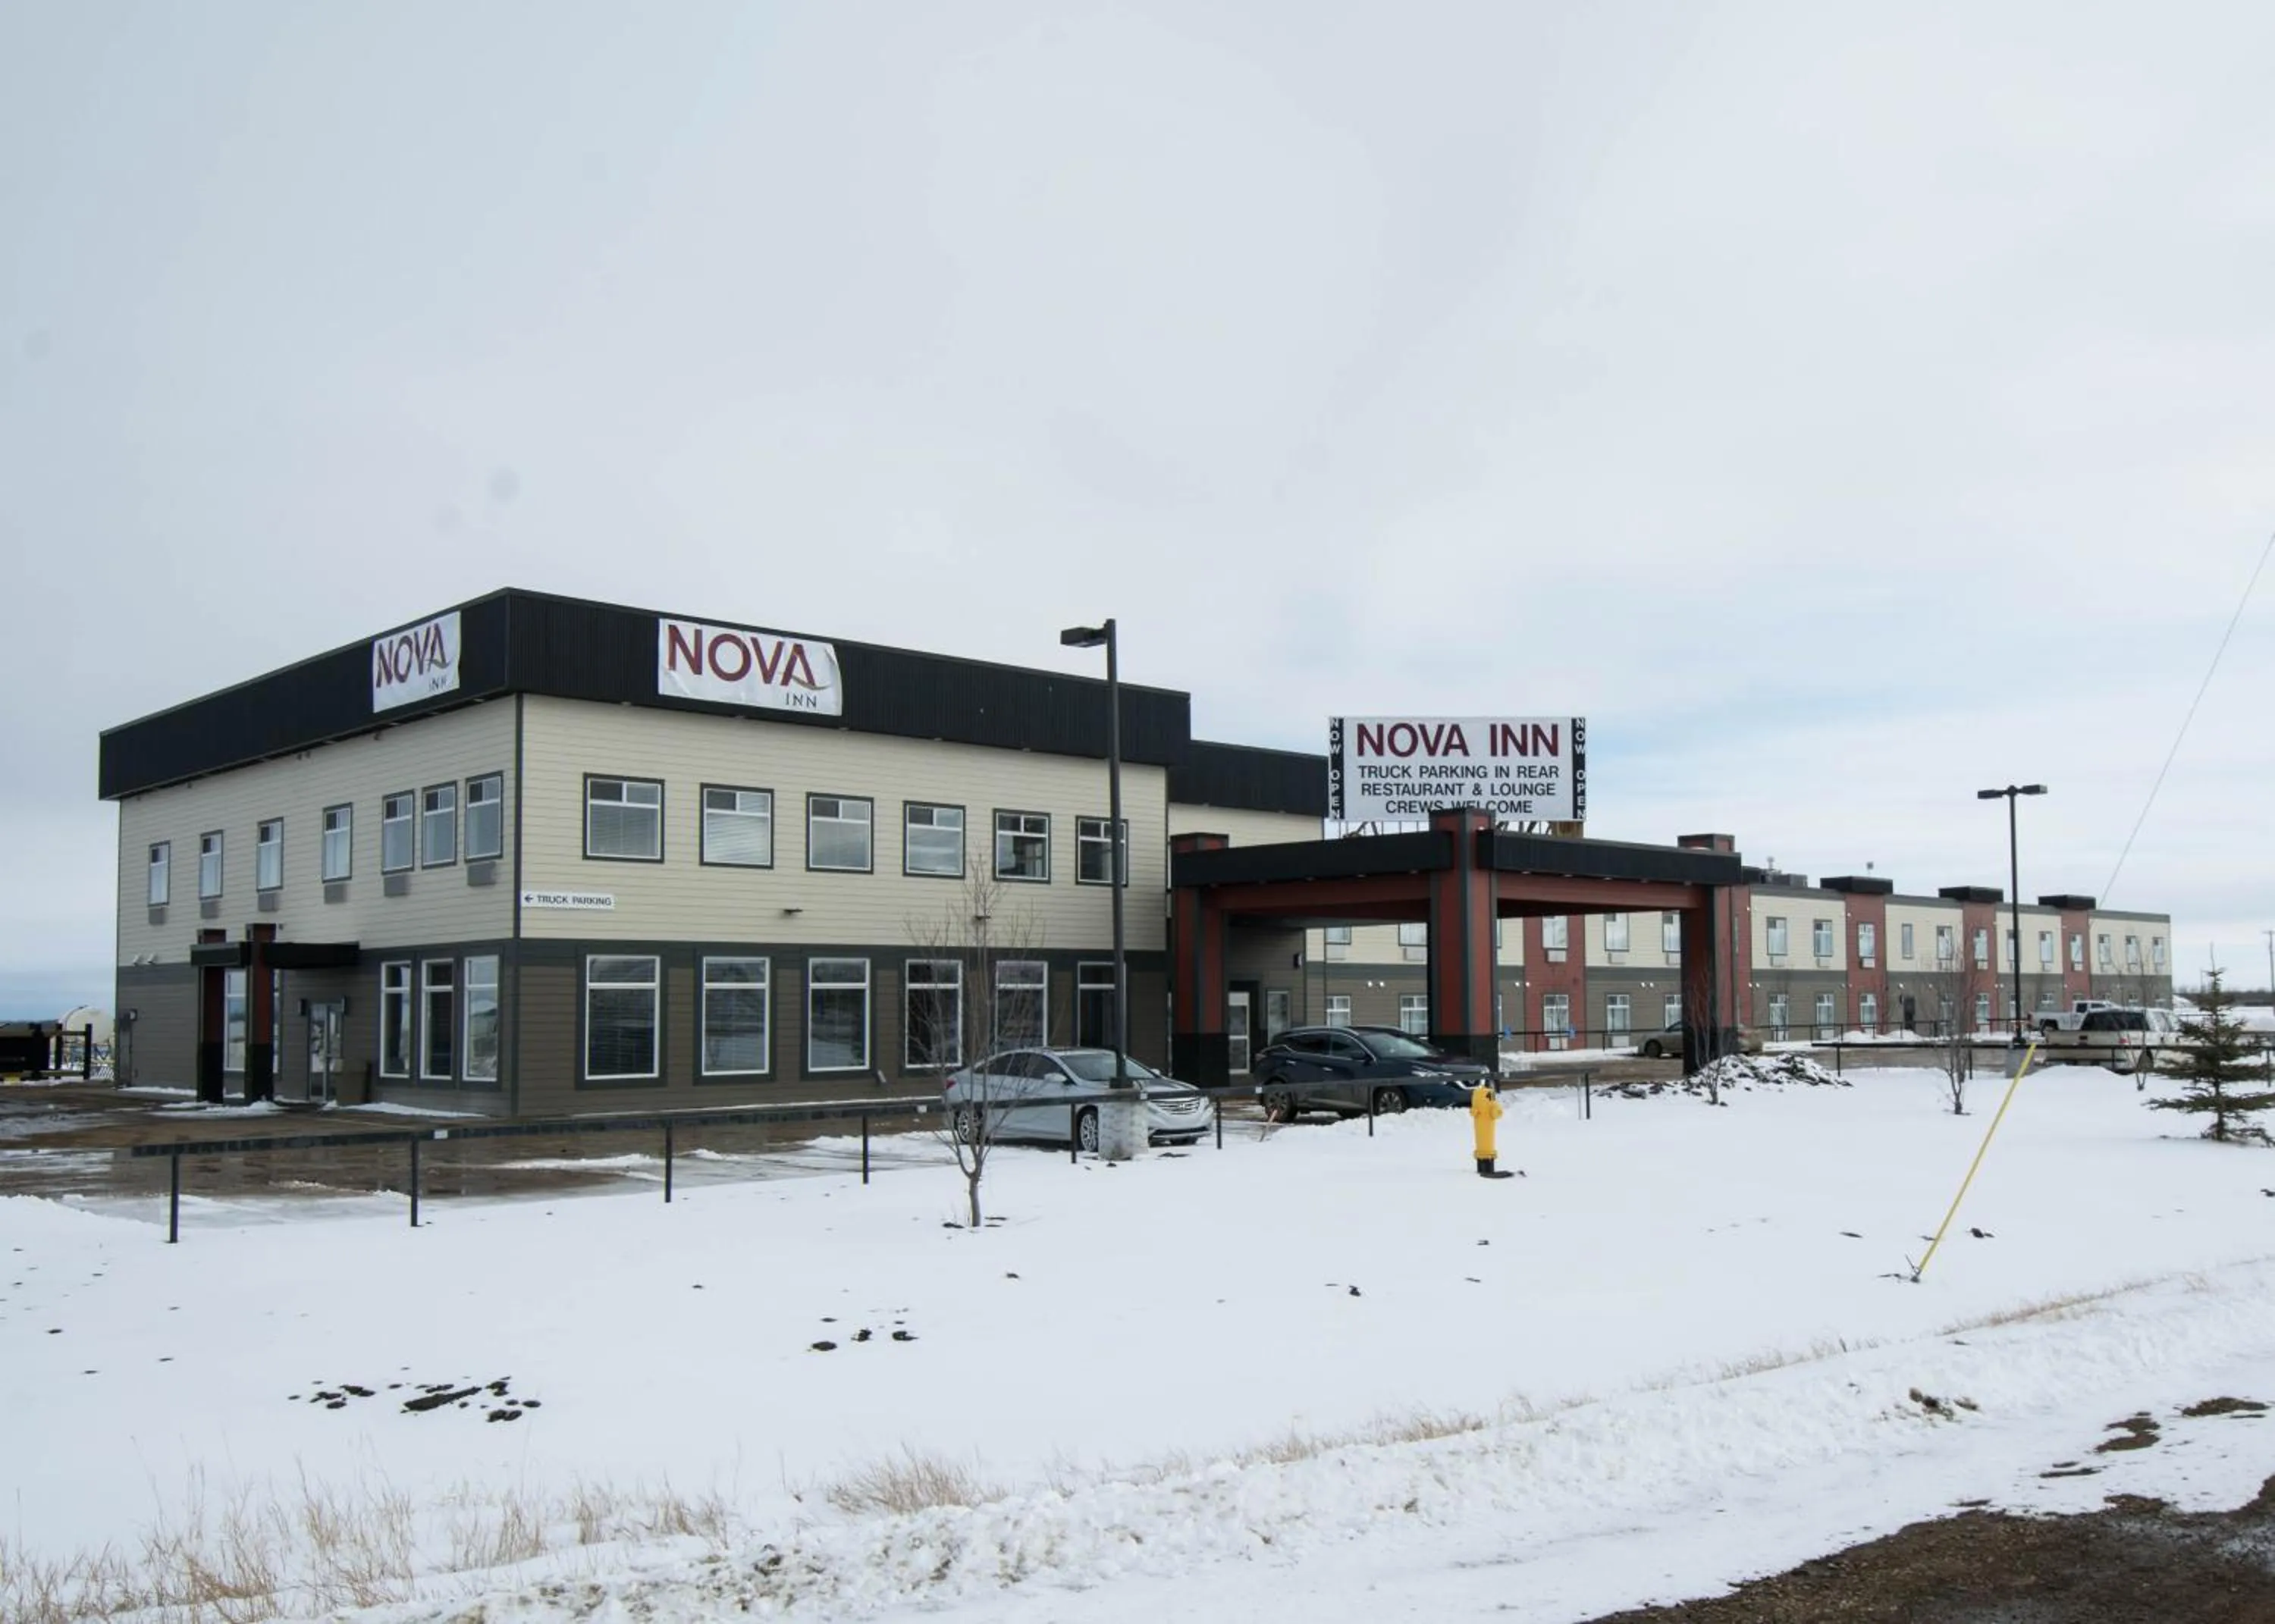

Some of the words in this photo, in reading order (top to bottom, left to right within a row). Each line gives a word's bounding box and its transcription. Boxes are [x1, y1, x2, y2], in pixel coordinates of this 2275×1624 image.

[376, 622, 448, 688] NOVA
[667, 624, 827, 690] NOVA
[785, 692, 817, 708] INN
[1330, 716, 1341, 754] NOW
[1357, 723, 1470, 757] NOVA
[1490, 723, 1559, 757] INN
[1575, 717, 1586, 754] NOW
[1359, 765, 1412, 779] TRUCK
[1419, 765, 1489, 779] PARKING
[1495, 765, 1510, 779] IN
[1517, 765, 1559, 779] REAR
[1361, 782, 1464, 796] RESTAURANT
[1471, 782, 1483, 796] &
[1490, 782, 1556, 796] LOUNGE
[1330, 770, 1341, 820] OPEN
[1385, 800, 1443, 814] CREWS
[1576, 770, 1586, 820] OPEN
[537, 895, 569, 904] TRUCK
[573, 895, 612, 906] PARKING
